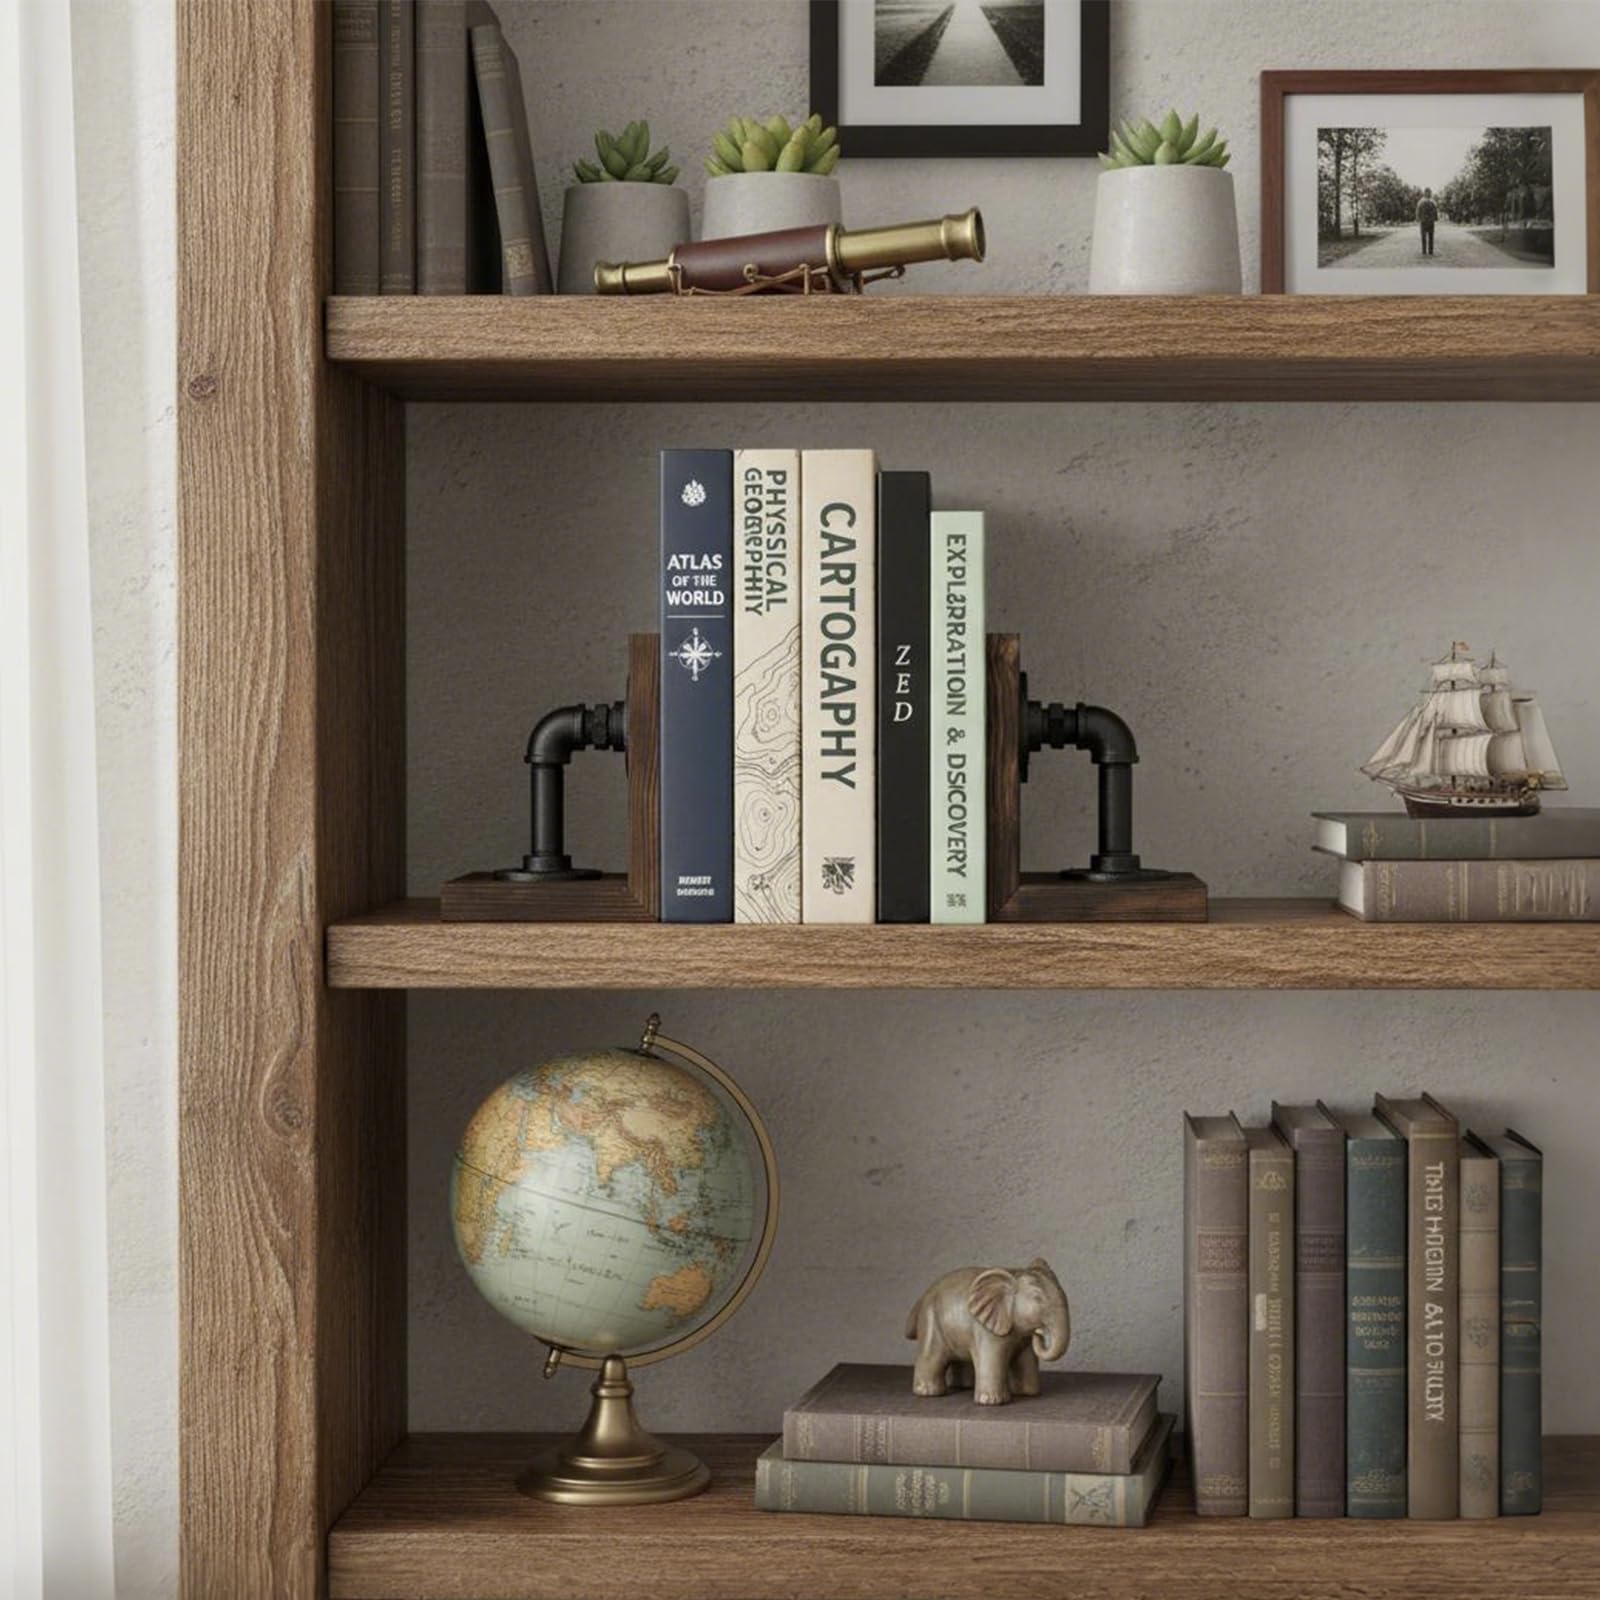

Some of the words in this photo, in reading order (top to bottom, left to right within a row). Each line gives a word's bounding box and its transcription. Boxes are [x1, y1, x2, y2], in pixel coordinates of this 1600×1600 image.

[667, 553, 723, 570] ATLAS
[766, 469, 787, 613] PHYSSICAL
[666, 590, 725, 606] WORLD
[672, 575, 690, 587] OF
[692, 575, 717, 587] THE
[820, 502, 857, 790] CARTOGAPHY
[893, 644, 913, 722] ZED
[947, 727, 966, 745] &
[946, 753, 967, 878] DSICOVERY
